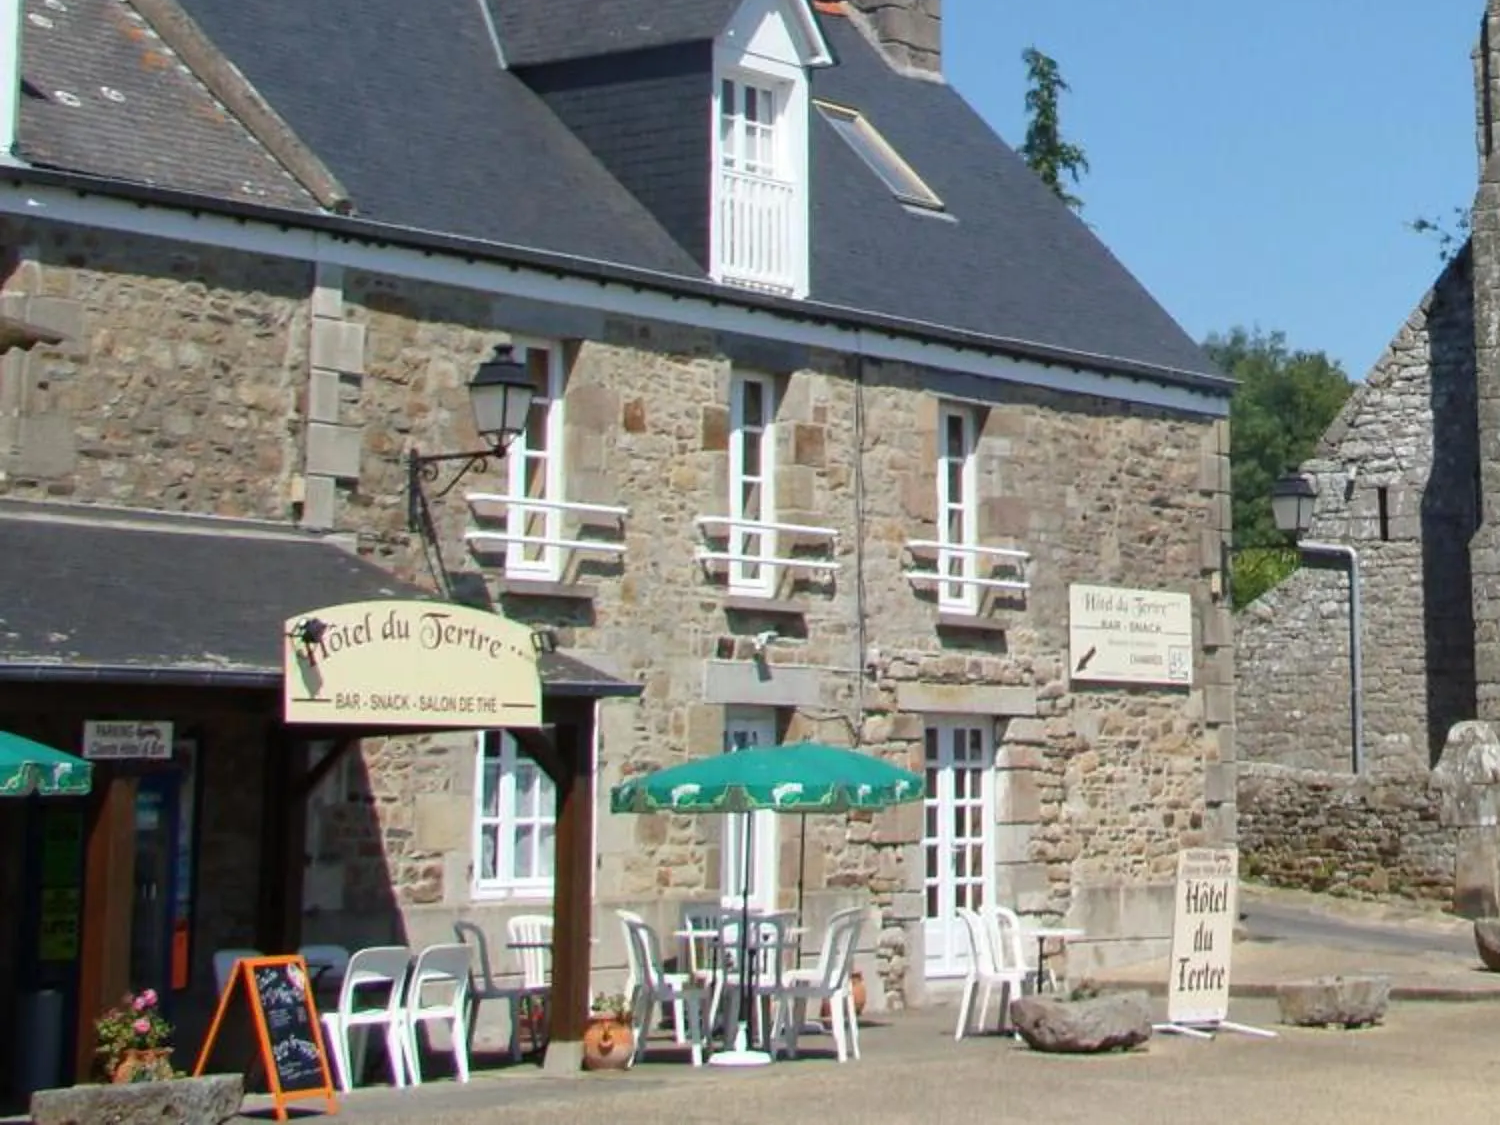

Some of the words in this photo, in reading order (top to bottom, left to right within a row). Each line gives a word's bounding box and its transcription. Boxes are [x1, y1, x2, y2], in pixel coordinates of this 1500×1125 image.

[382, 610, 410, 640] du
[420, 612, 502, 659] Tertre
[336, 692, 360, 710] BAR
[370, 693, 410, 711] SNACK
[419, 695, 456, 712] SALON
[459, 696, 474, 713] DE
[1185, 880, 1228, 914] Hôtel
[1193, 921, 1213, 952] du
[1178, 958, 1225, 992] Tertre
